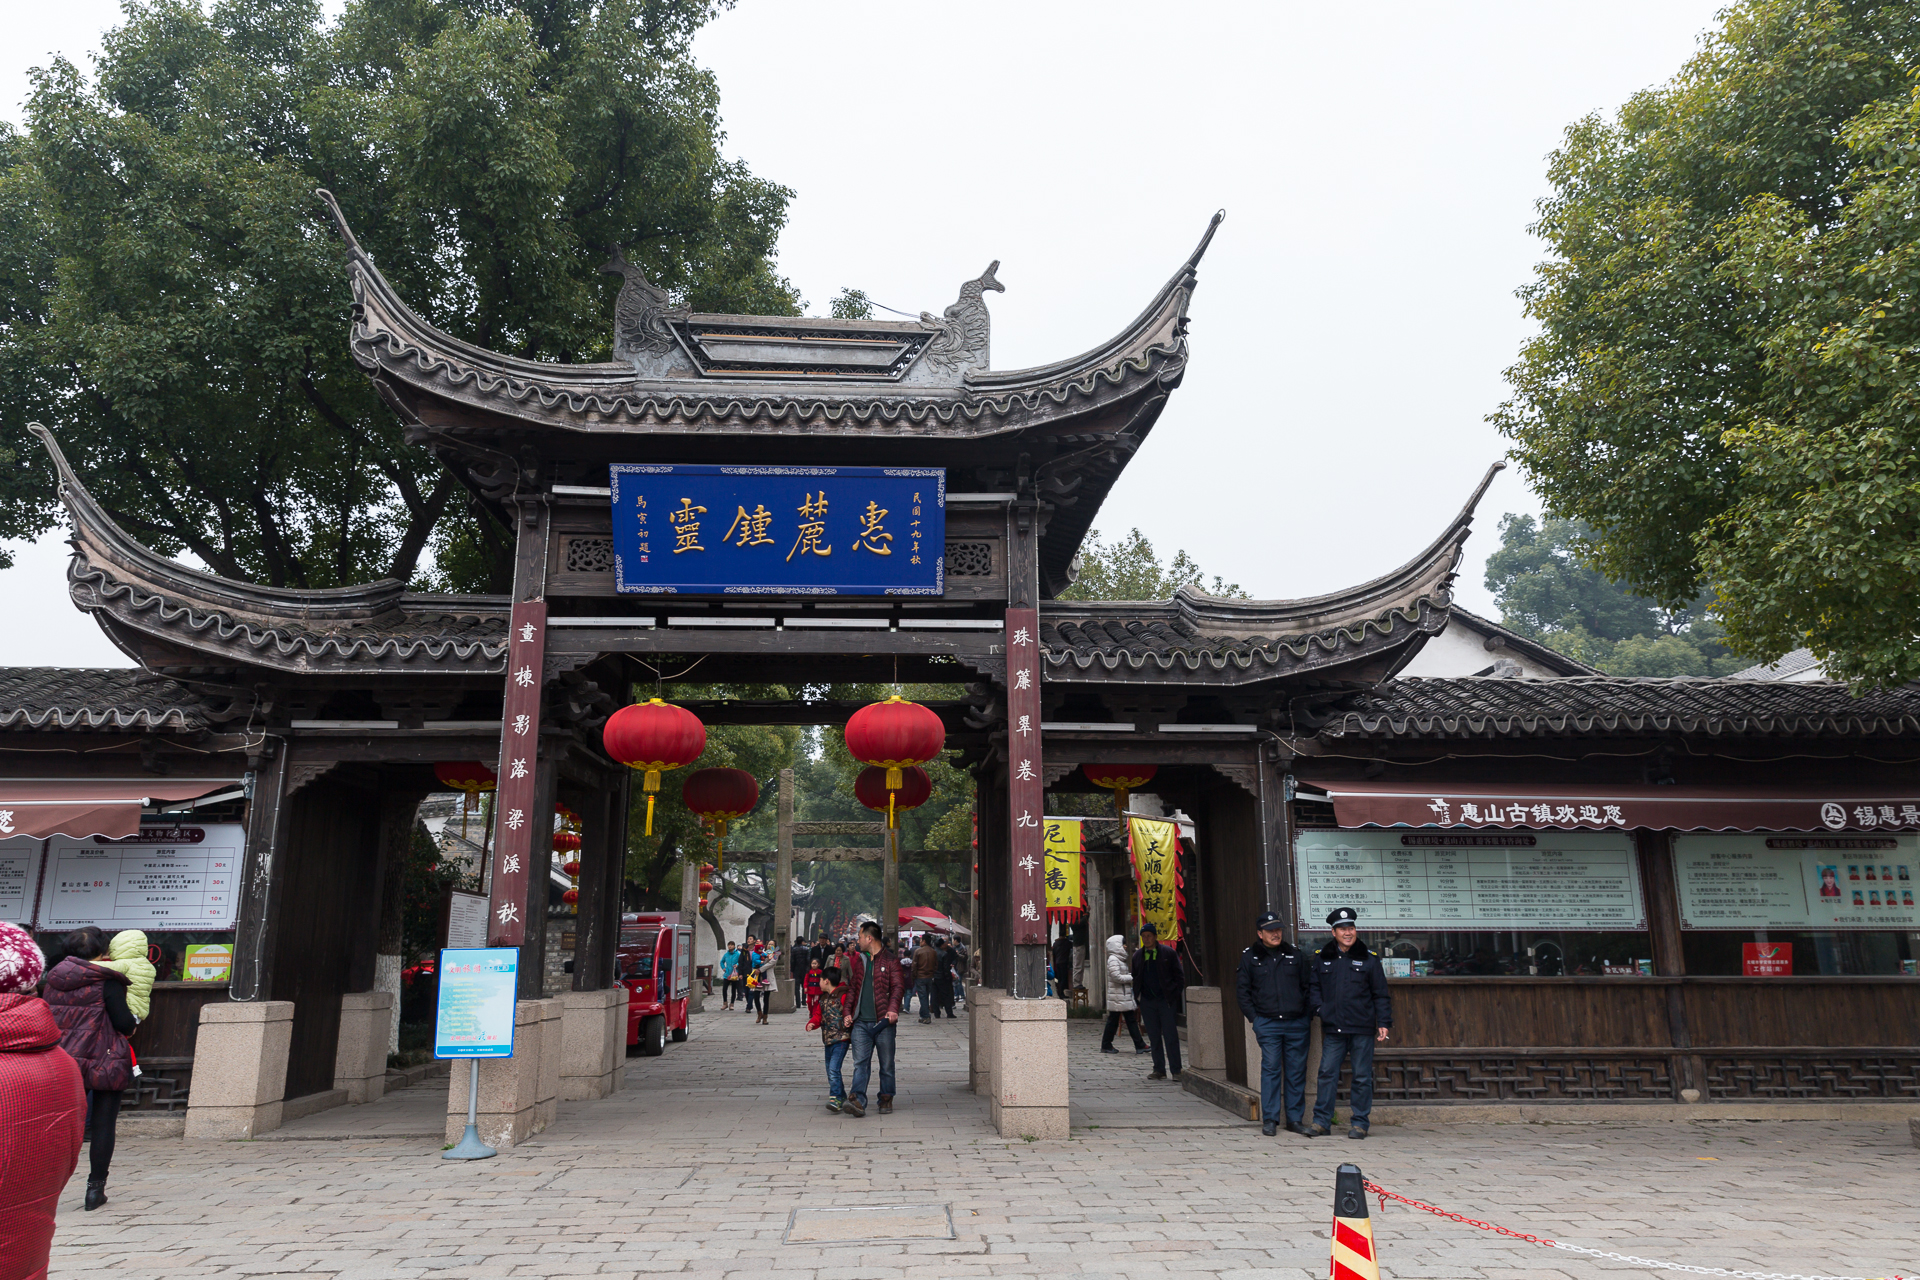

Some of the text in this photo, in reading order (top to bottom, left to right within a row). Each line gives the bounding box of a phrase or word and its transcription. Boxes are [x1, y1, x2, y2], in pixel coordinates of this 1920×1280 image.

[1460, 802, 1626, 825] 惠山古镇欢迎您
[1853, 804, 1920, 826] 锡惠景
[1144, 840, 1166, 913] 天顺油酥
